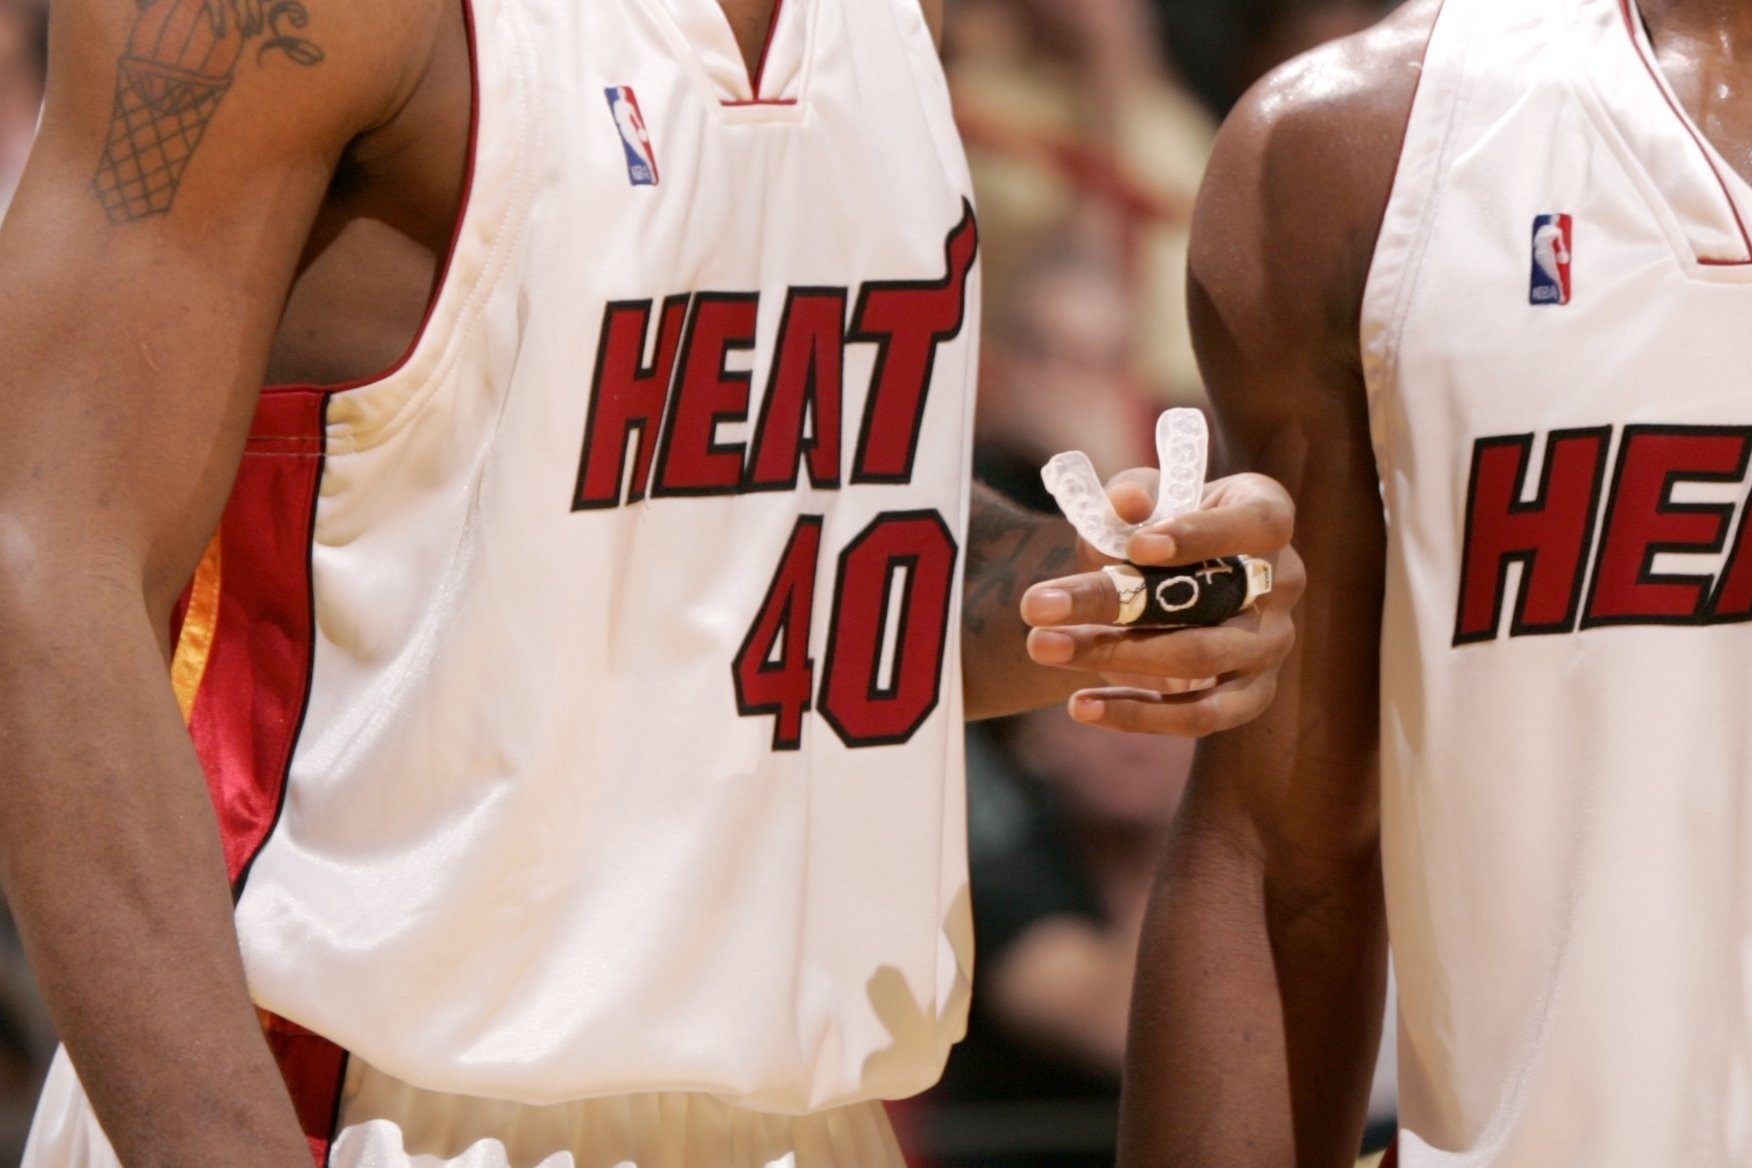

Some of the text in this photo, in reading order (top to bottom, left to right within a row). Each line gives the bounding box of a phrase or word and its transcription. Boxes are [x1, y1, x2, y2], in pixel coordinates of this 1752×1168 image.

[571, 195, 979, 512] HEAT
[1531, 285, 1558, 301] NBA
[731, 508, 959, 751] 40
